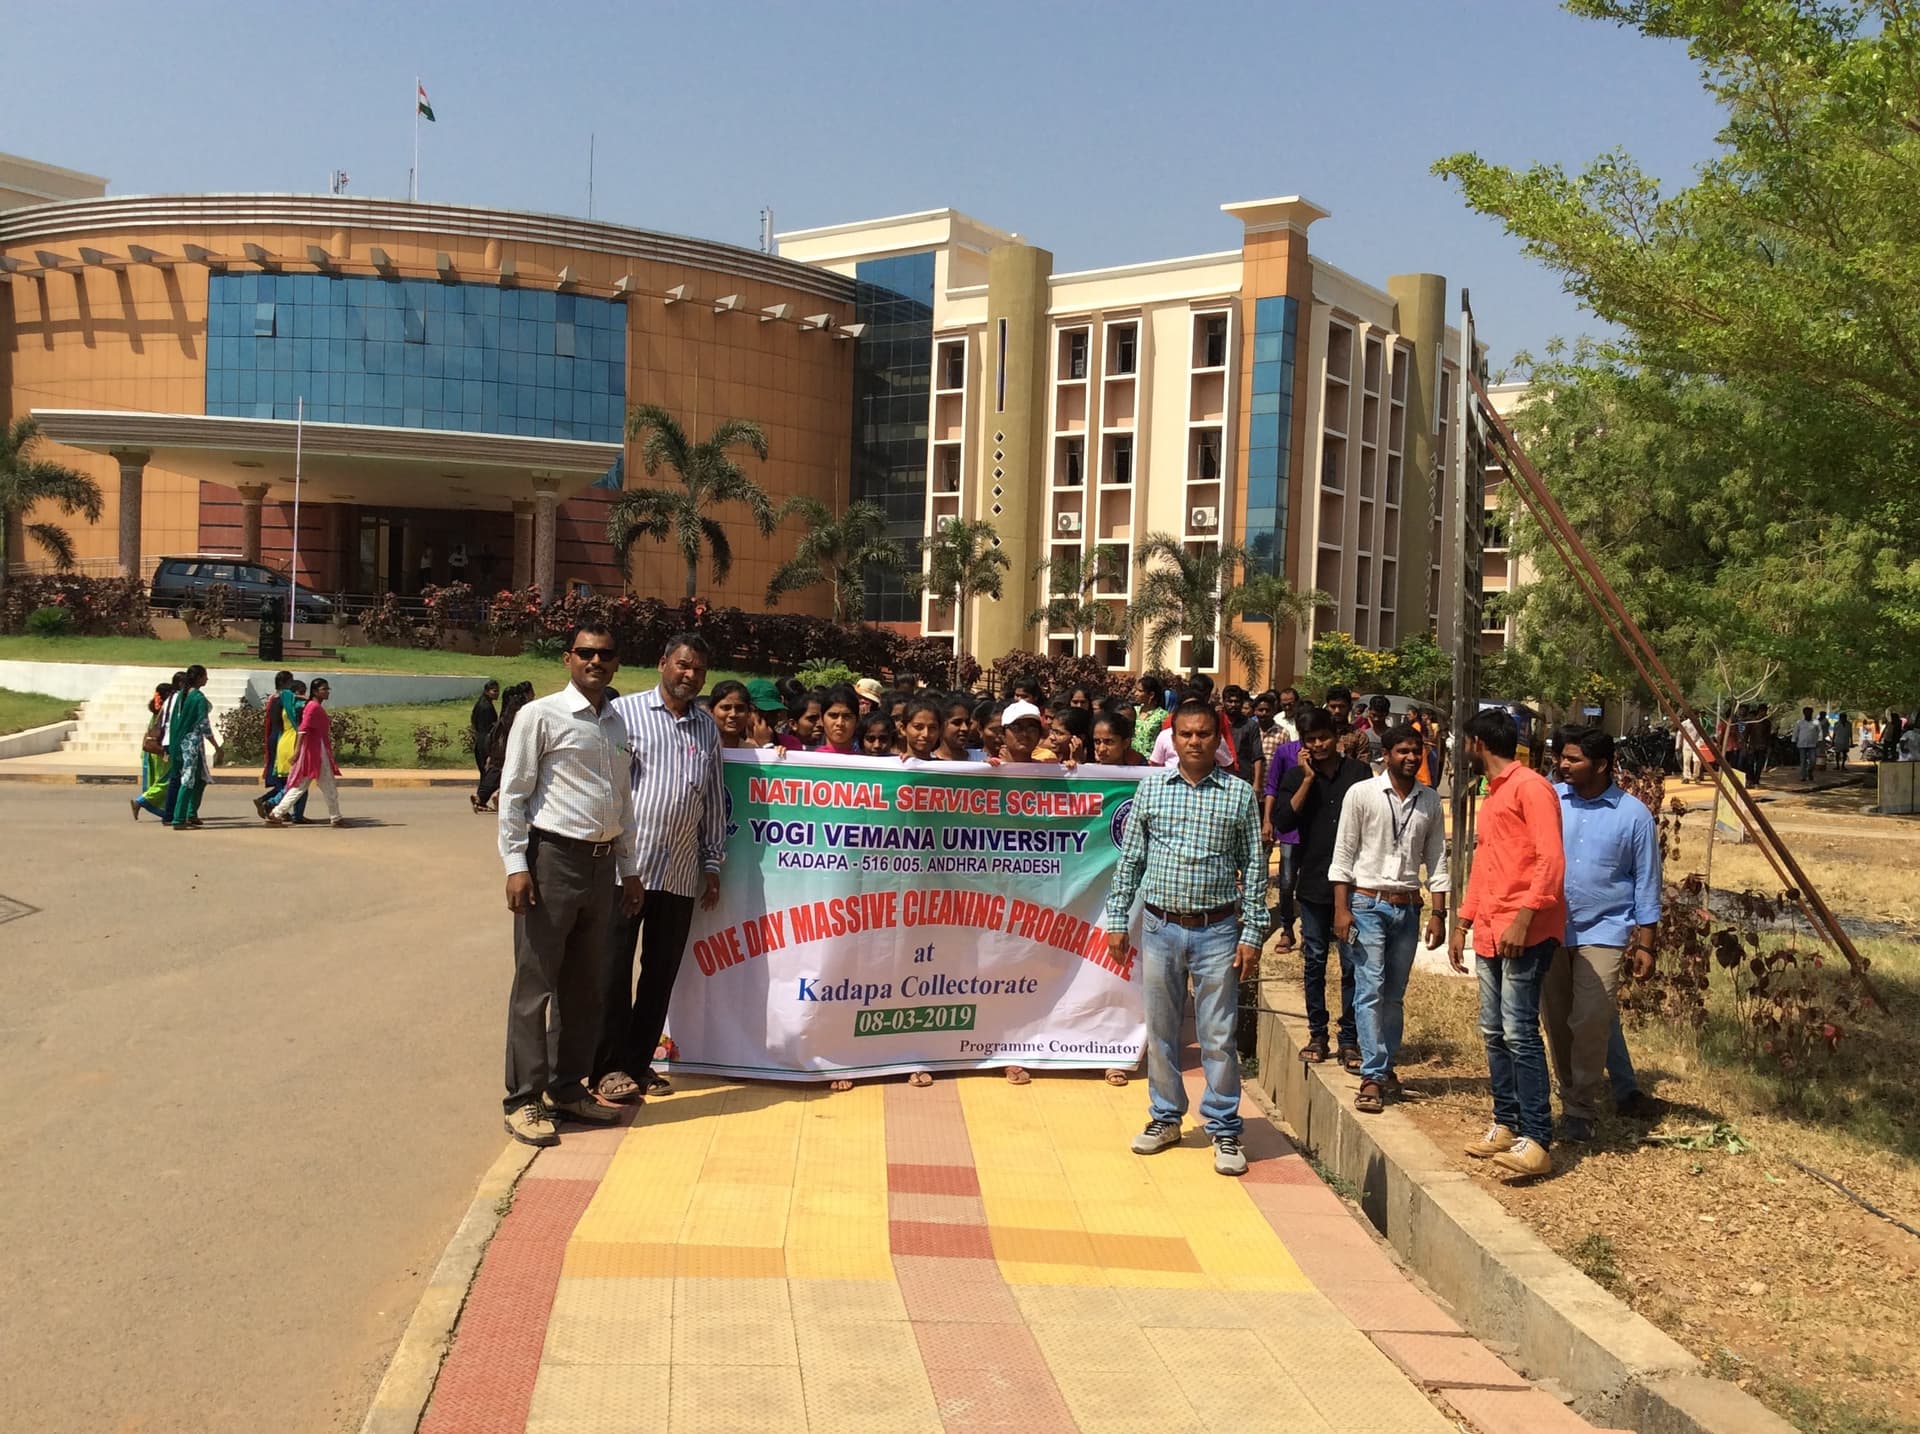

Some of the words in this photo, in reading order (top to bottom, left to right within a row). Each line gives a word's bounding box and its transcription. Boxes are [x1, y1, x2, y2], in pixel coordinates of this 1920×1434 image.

[749, 776, 889, 810] NATIONAL
[896, 784, 1001, 815] SERVICE
[1006, 790, 1104, 817] SCHEME
[750, 819, 815, 846] YOGI
[823, 822, 936, 851] VEMANA
[942, 827, 1089, 854] UNIVERSITY
[778, 852, 848, 871] KADAPA
[862, 855, 888, 871] 516
[926, 857, 988, 873] ANDHRA
[991, 858, 1061, 875] PRADESH
[693, 926, 745, 976] ONE
[742, 910, 785, 959] DAY
[789, 891, 897, 945] MASSIVE
[902, 889, 1006, 931] CLEANING
[914, 942, 935, 964] at
[797, 977, 892, 1006] Kadapa
[900, 974, 1038, 999] Collectorate
[858, 1006, 973, 1034] 08-03-2019
[959, 1039, 1045, 1056] Programme
[1049, 1039, 1140, 1055] Coordinator
